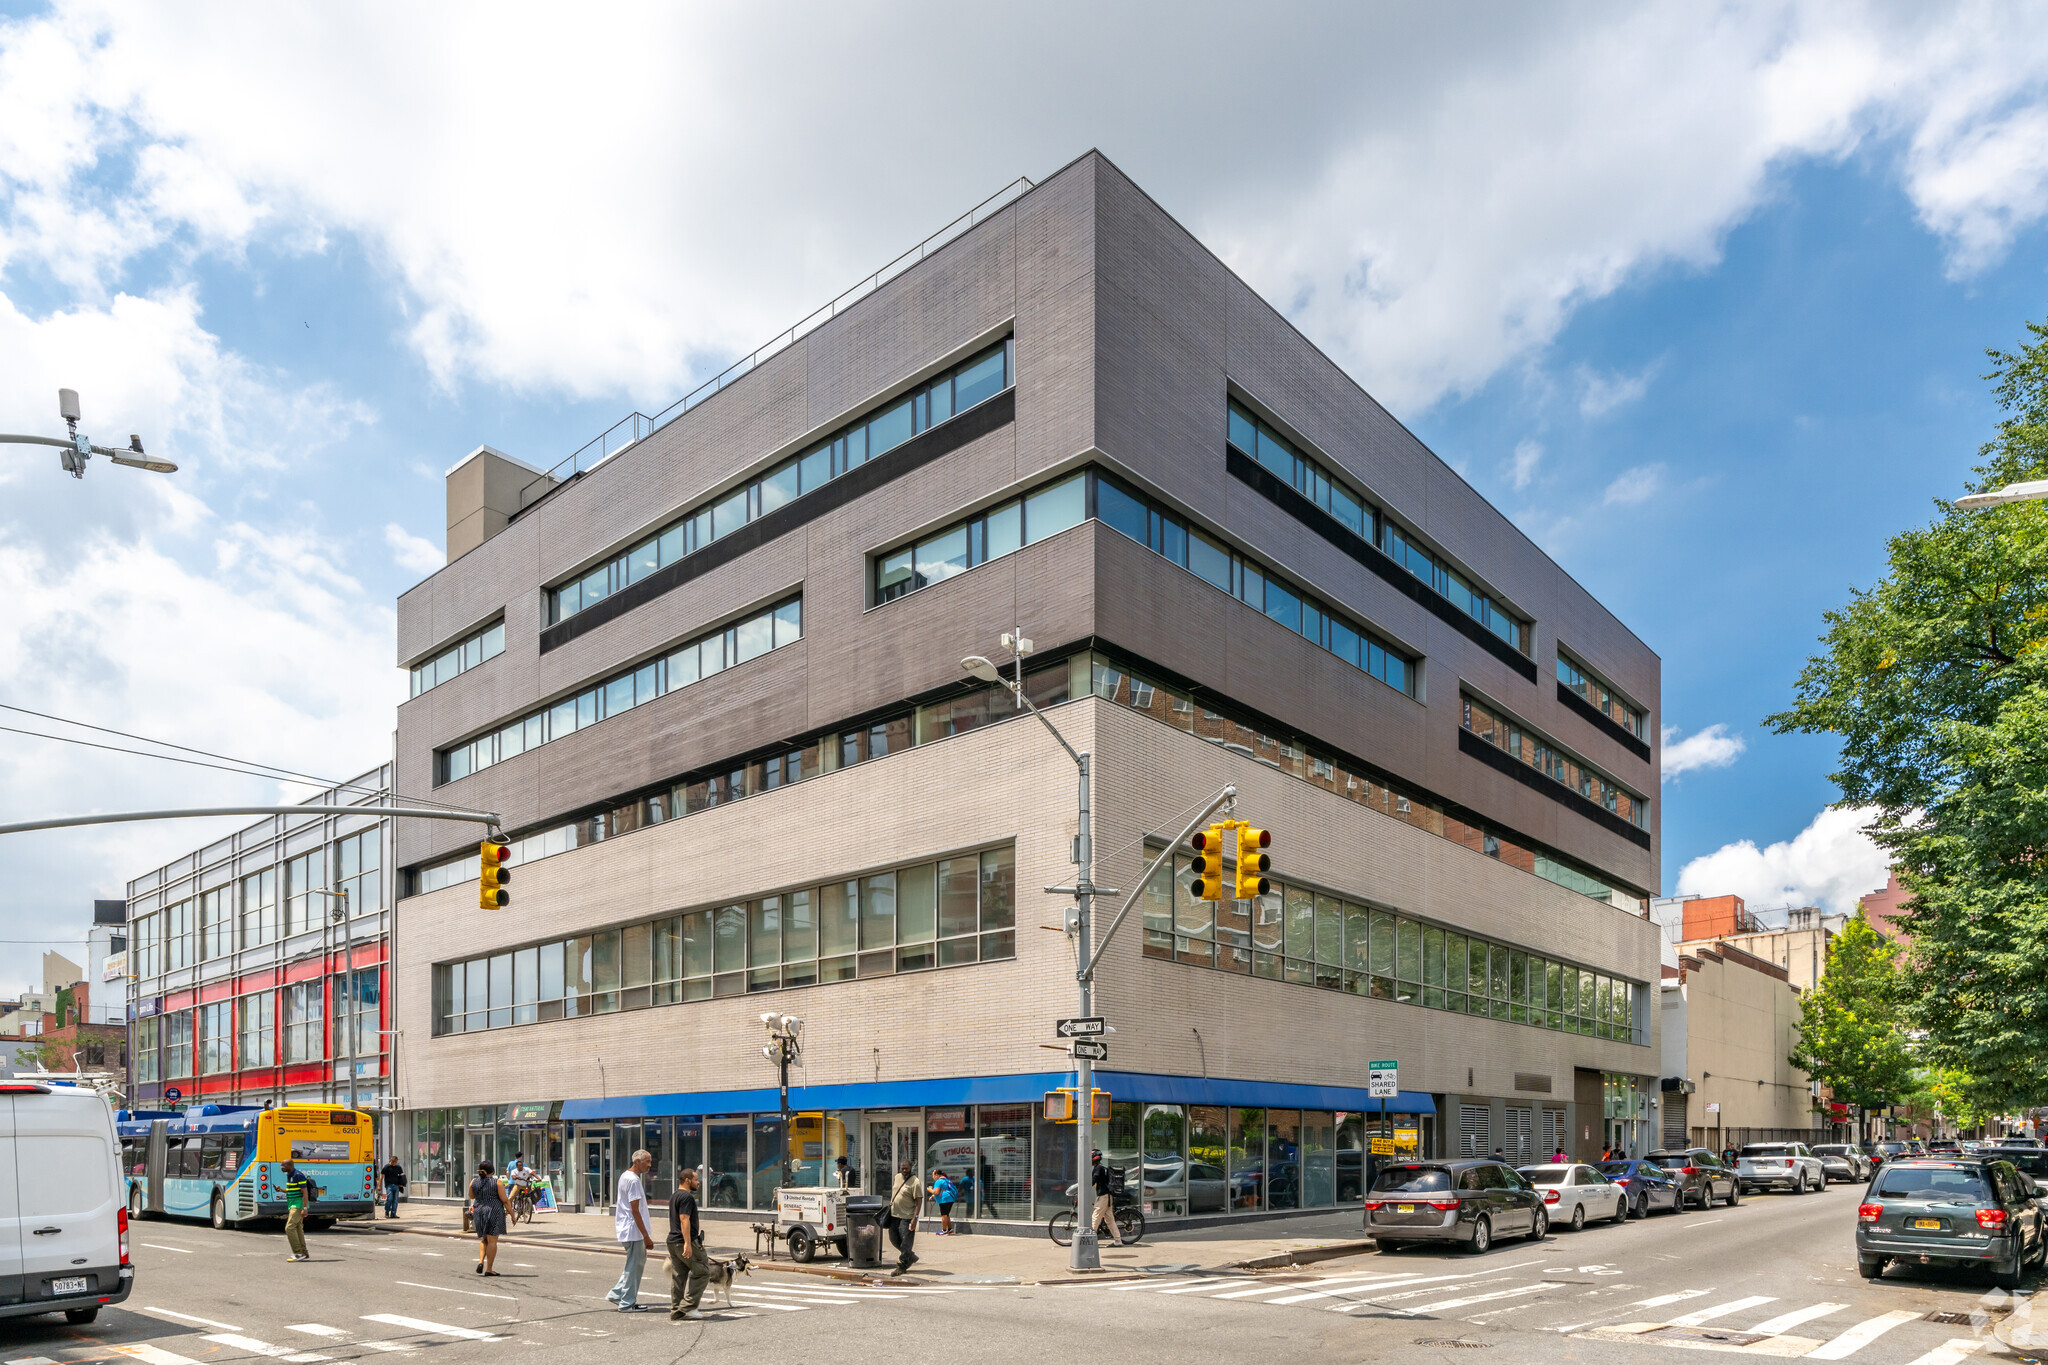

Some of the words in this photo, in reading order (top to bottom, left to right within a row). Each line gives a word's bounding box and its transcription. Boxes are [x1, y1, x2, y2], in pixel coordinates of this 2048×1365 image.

[1063, 1024, 1077, 1032] ONE
[1085, 1022, 1099, 1031] WAY
[1077, 1045, 1087, 1054] ONE
[1092, 1047, 1103, 1055] WAY
